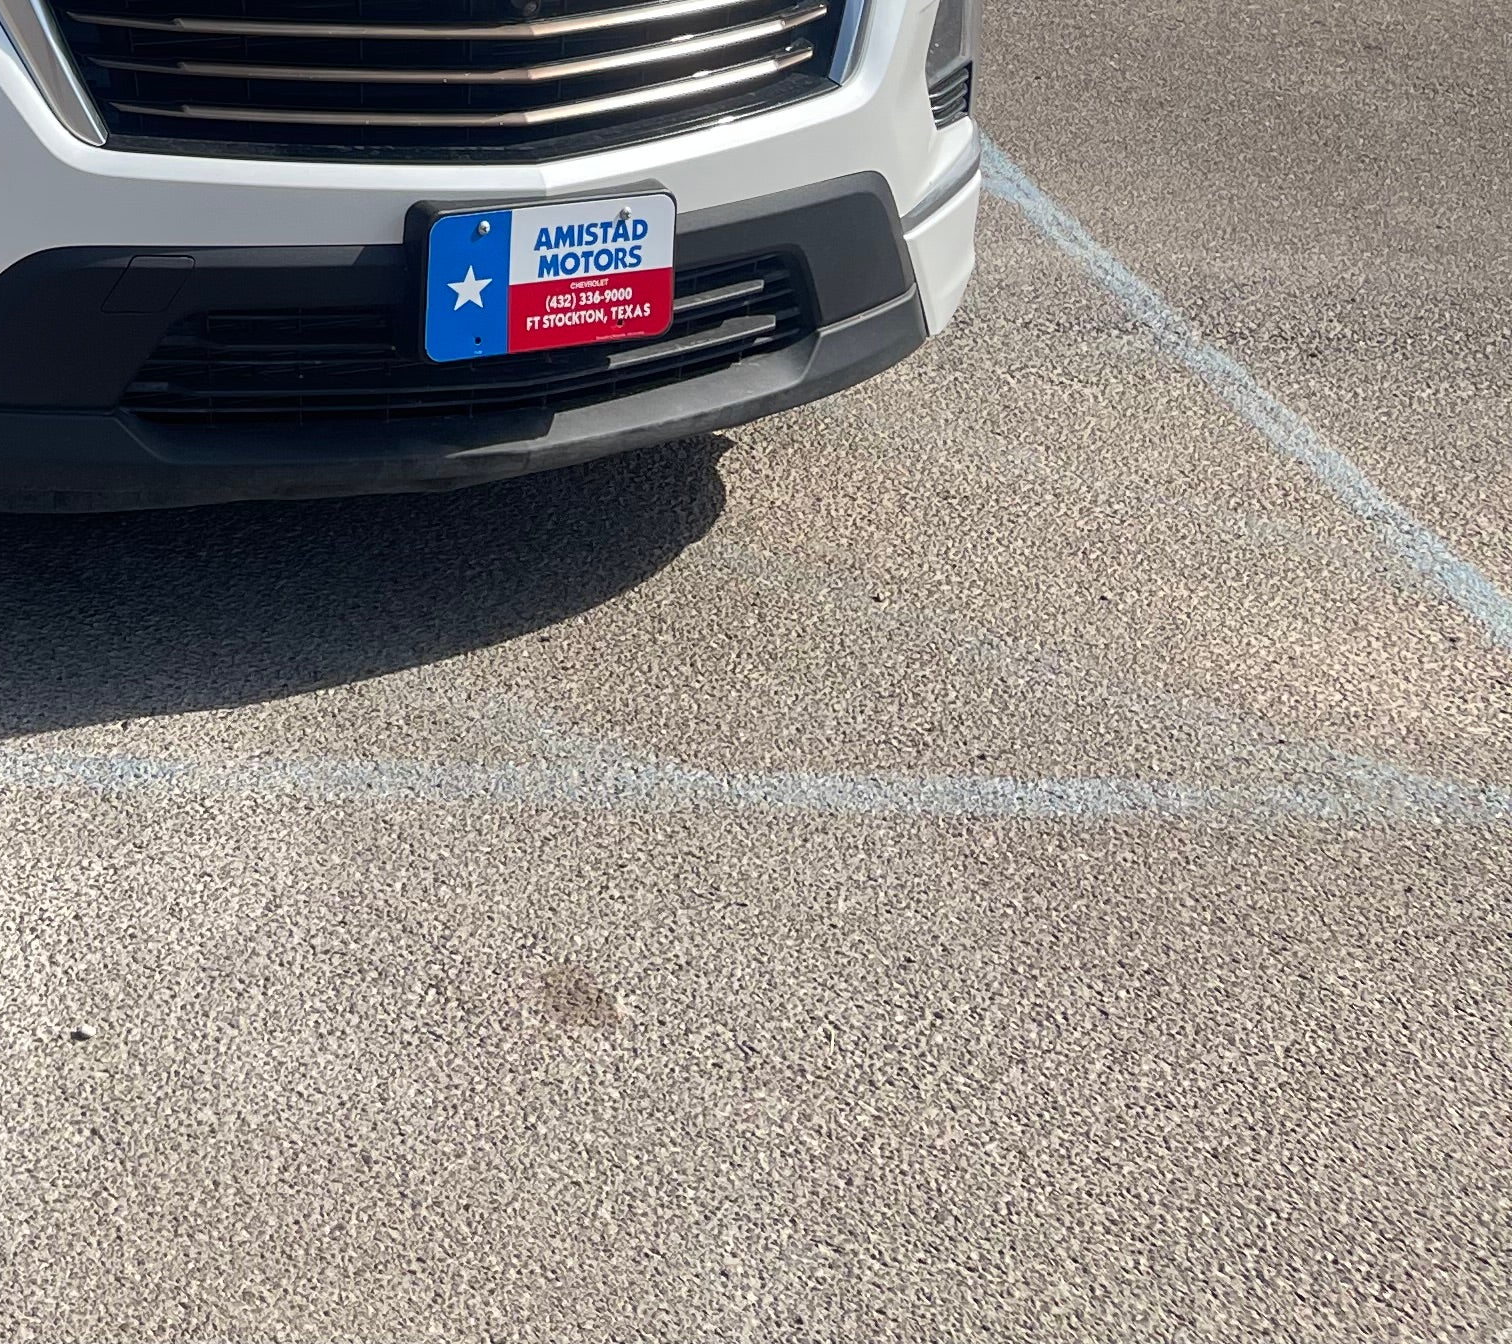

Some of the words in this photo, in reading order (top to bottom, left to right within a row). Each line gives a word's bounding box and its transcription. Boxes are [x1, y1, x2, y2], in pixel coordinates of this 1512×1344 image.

[534, 219, 648, 251] AMISTAD
[538, 245, 642, 278] MOTORS
[546, 293, 576, 312] (432)
[579, 287, 632, 305] 336-9000
[527, 316, 540, 330] FT
[543, 308, 607, 328] STOCKTON,
[611, 303, 651, 320] TEXAS
